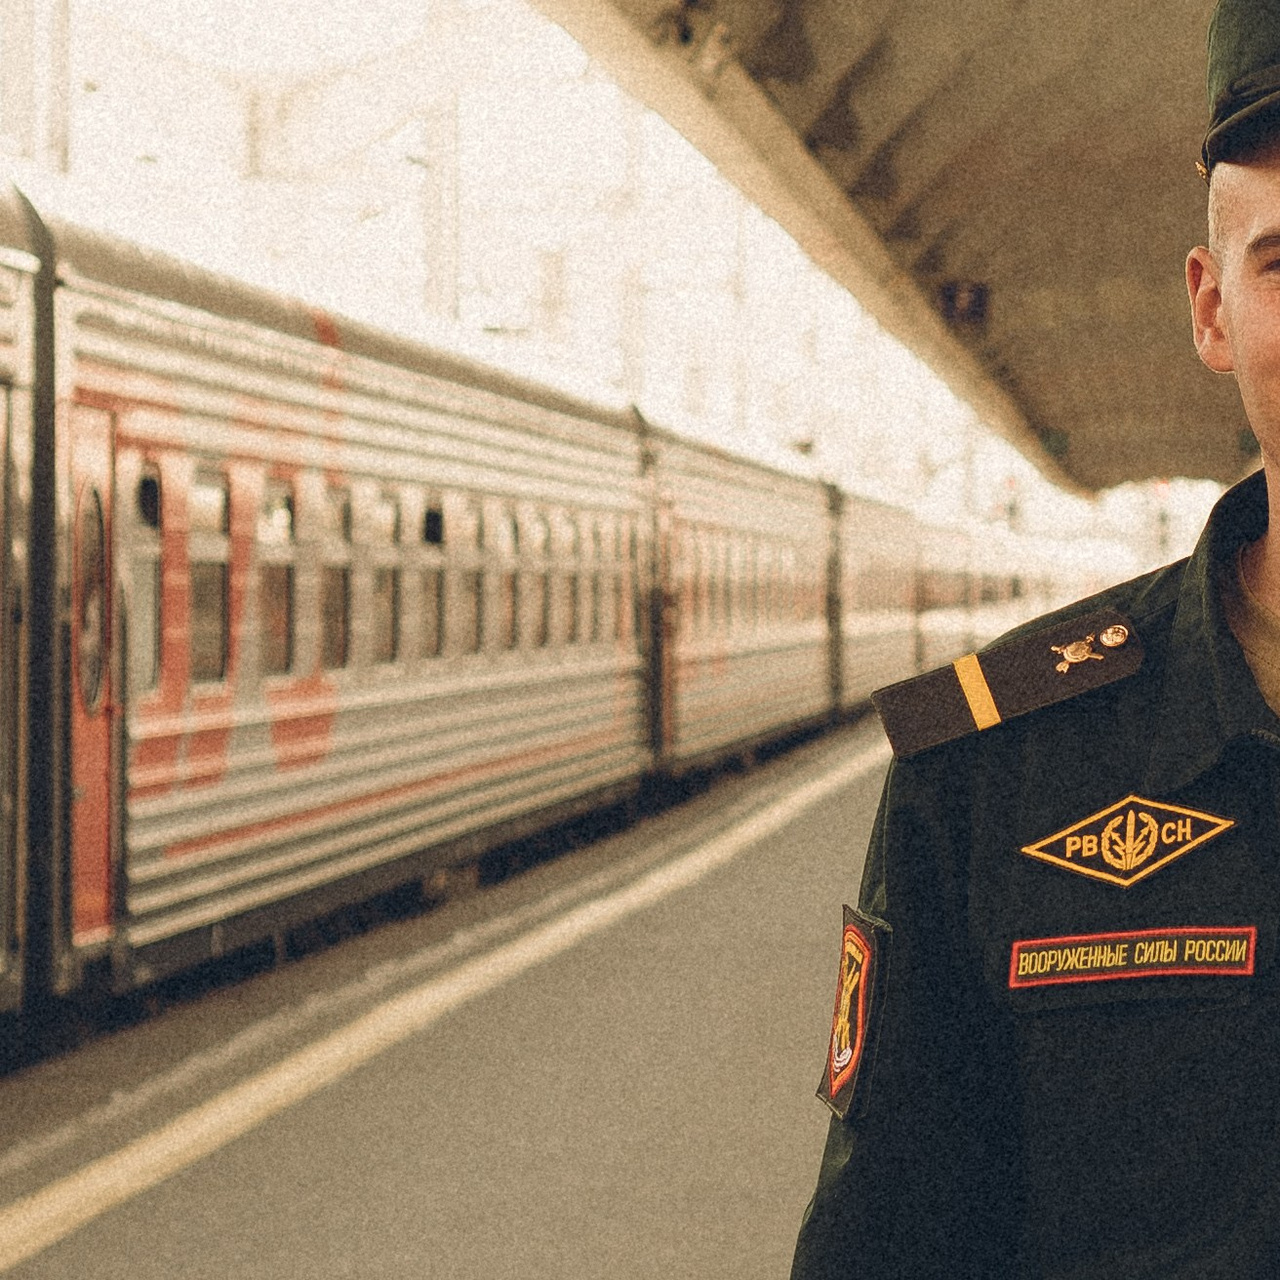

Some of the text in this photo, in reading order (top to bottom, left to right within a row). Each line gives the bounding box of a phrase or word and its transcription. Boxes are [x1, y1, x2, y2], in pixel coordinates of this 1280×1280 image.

[1065, 818, 1192, 858] РВ СН
[1017, 938, 1248, 976] ВООРУЖЕННЫЕ СИЛЫ РОССИИ
